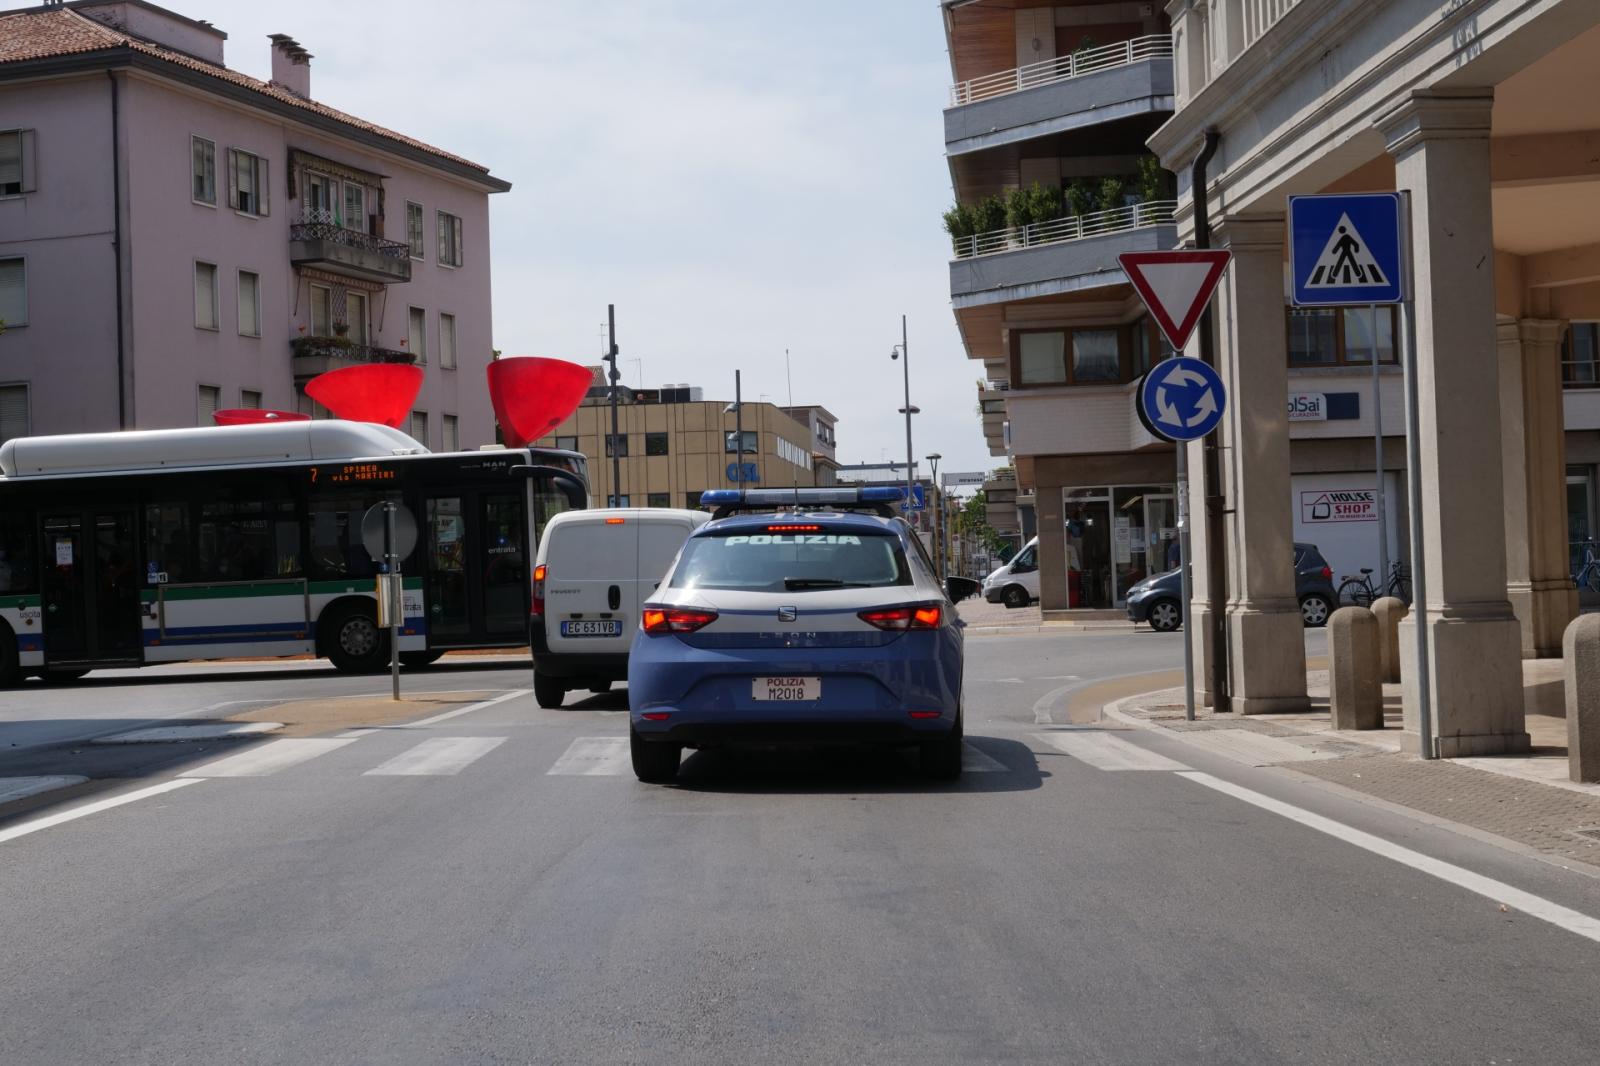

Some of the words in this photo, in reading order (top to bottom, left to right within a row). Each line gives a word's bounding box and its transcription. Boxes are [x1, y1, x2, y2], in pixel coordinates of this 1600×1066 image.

[311, 468, 318, 482] 7
[1329, 492, 1374, 502] HOUSE
[1335, 504, 1371, 514] SHOP
[724, 535, 862, 546] POLIZIA
[767, 679, 805, 687] POLIZIA
[768, 688, 804, 700] M2018
